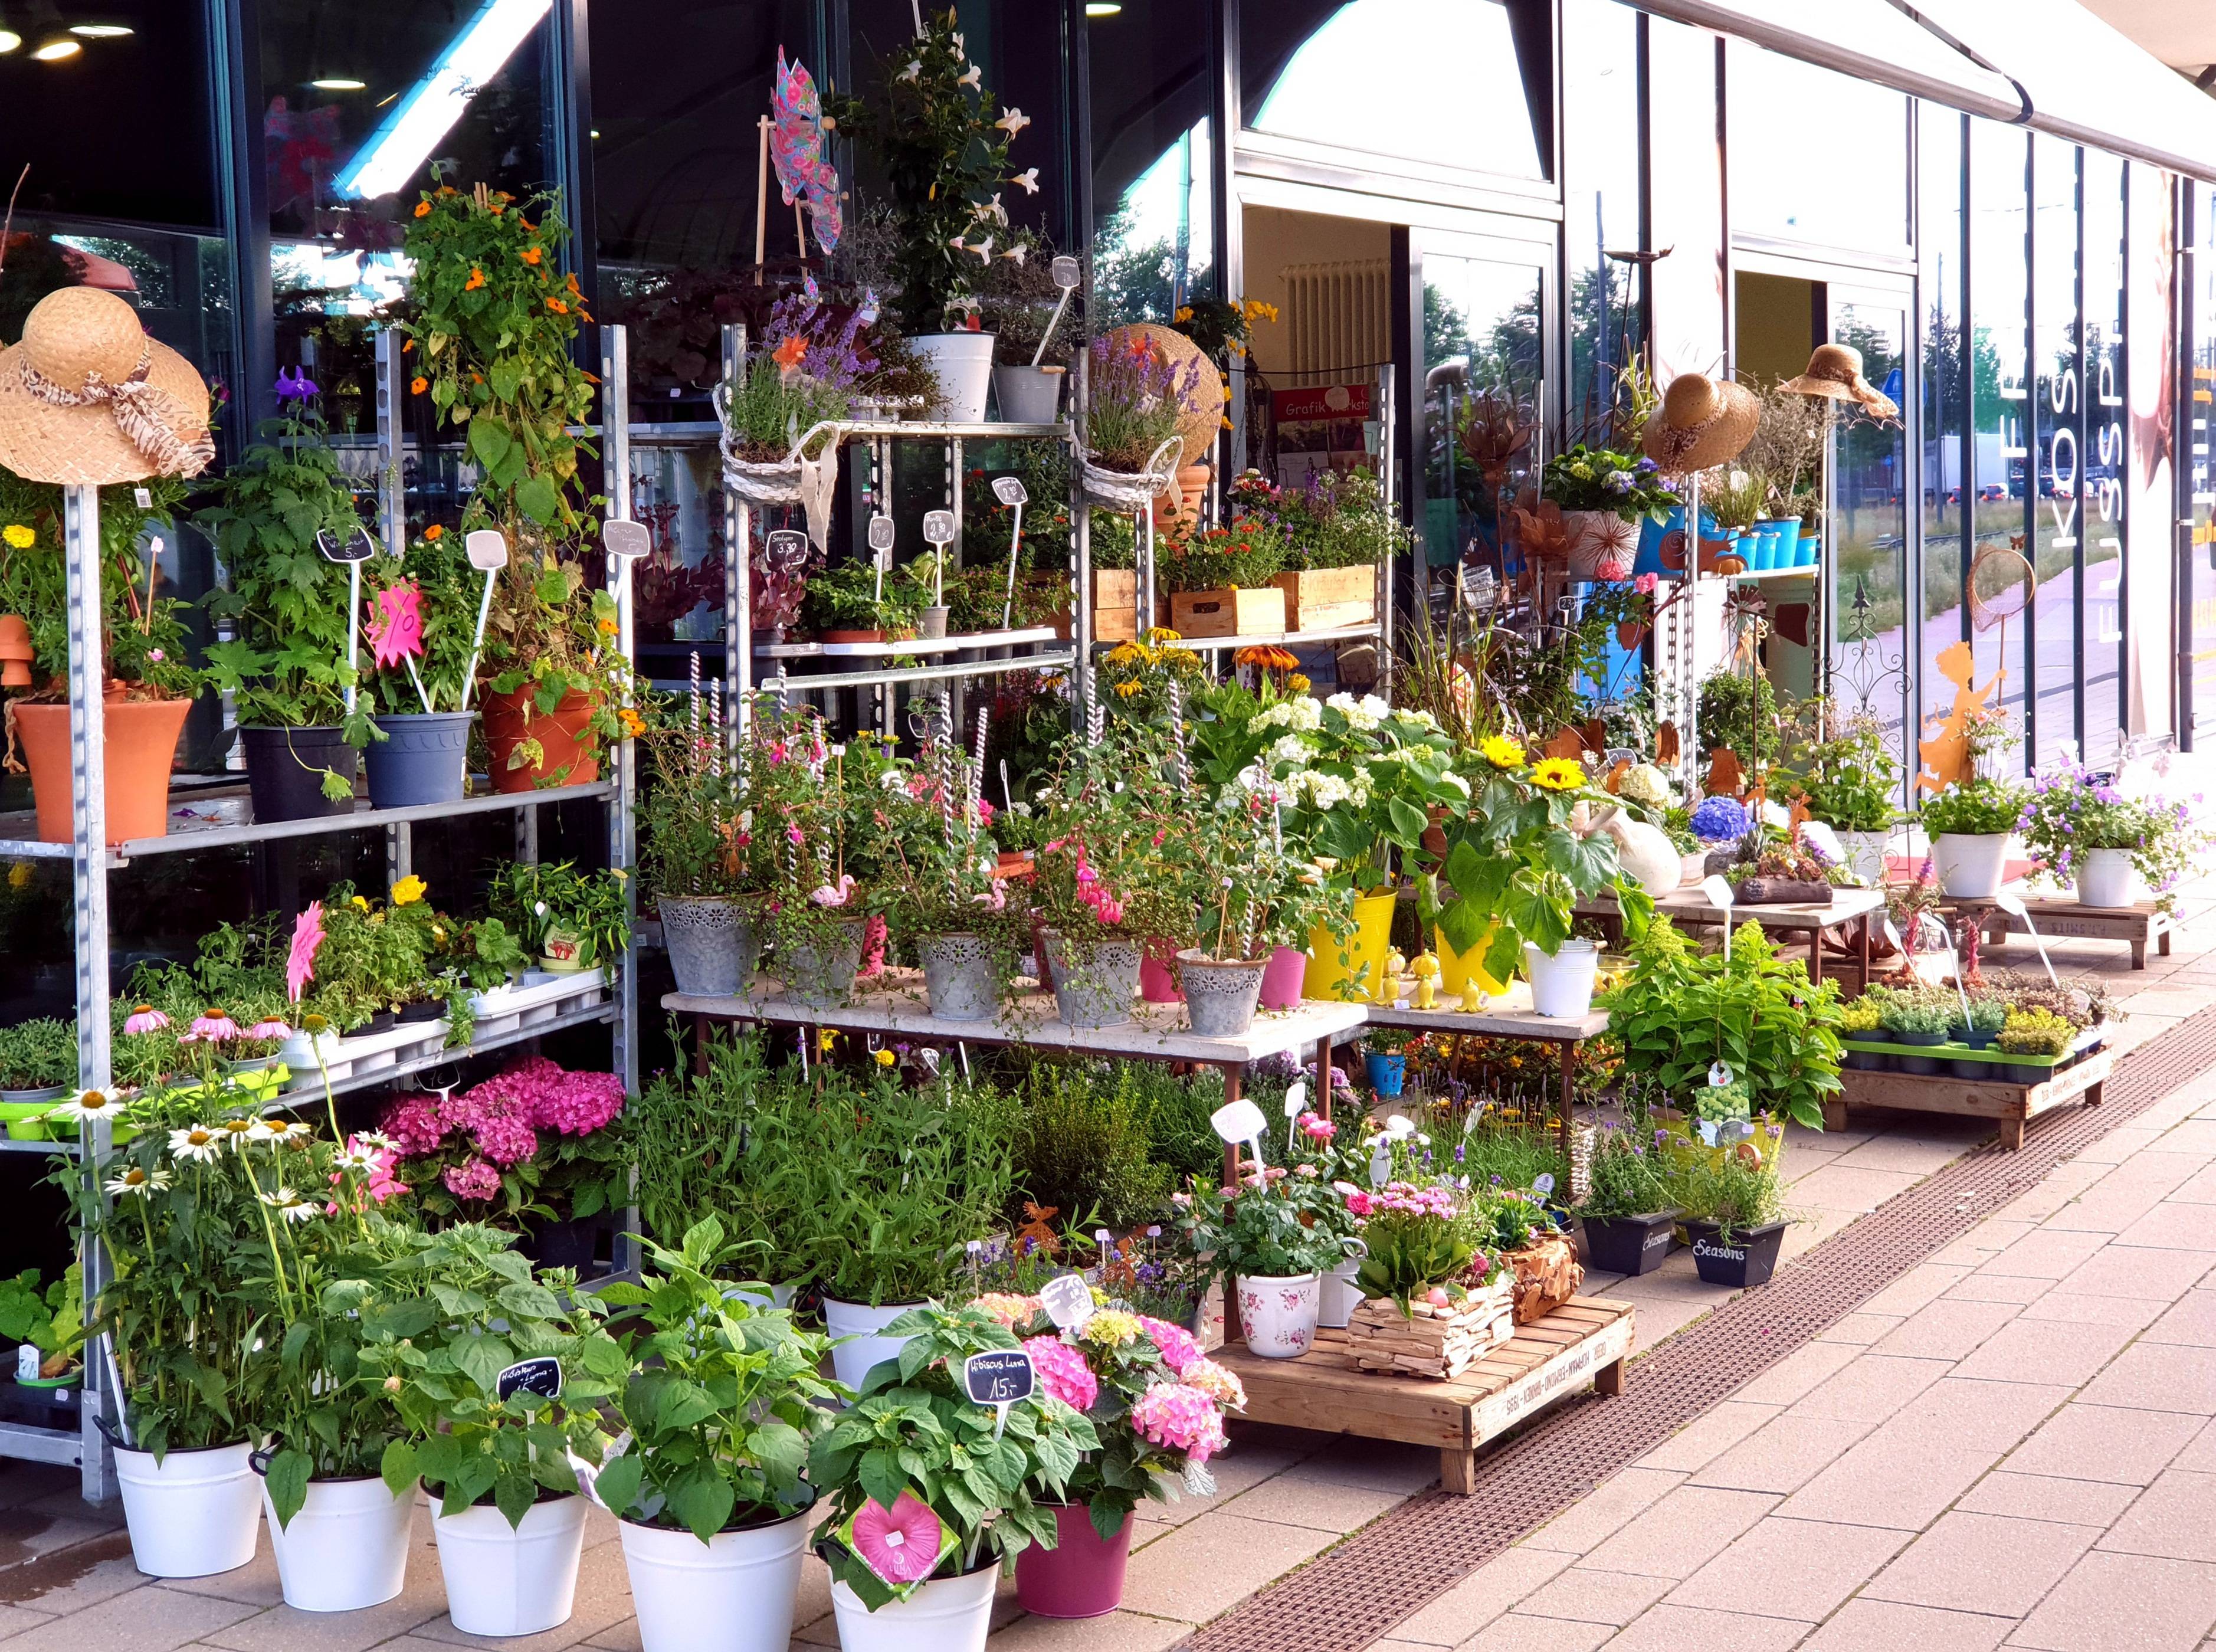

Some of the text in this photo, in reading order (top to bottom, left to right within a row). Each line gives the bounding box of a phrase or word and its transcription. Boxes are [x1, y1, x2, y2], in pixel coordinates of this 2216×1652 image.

[1286, 400, 1326, 415] Grafik
[1692, 1238, 1745, 1261] Seasons
[970, 1354, 1026, 1373] Hibiscus Luna
[889, 1564, 912, 1573] LUNA
